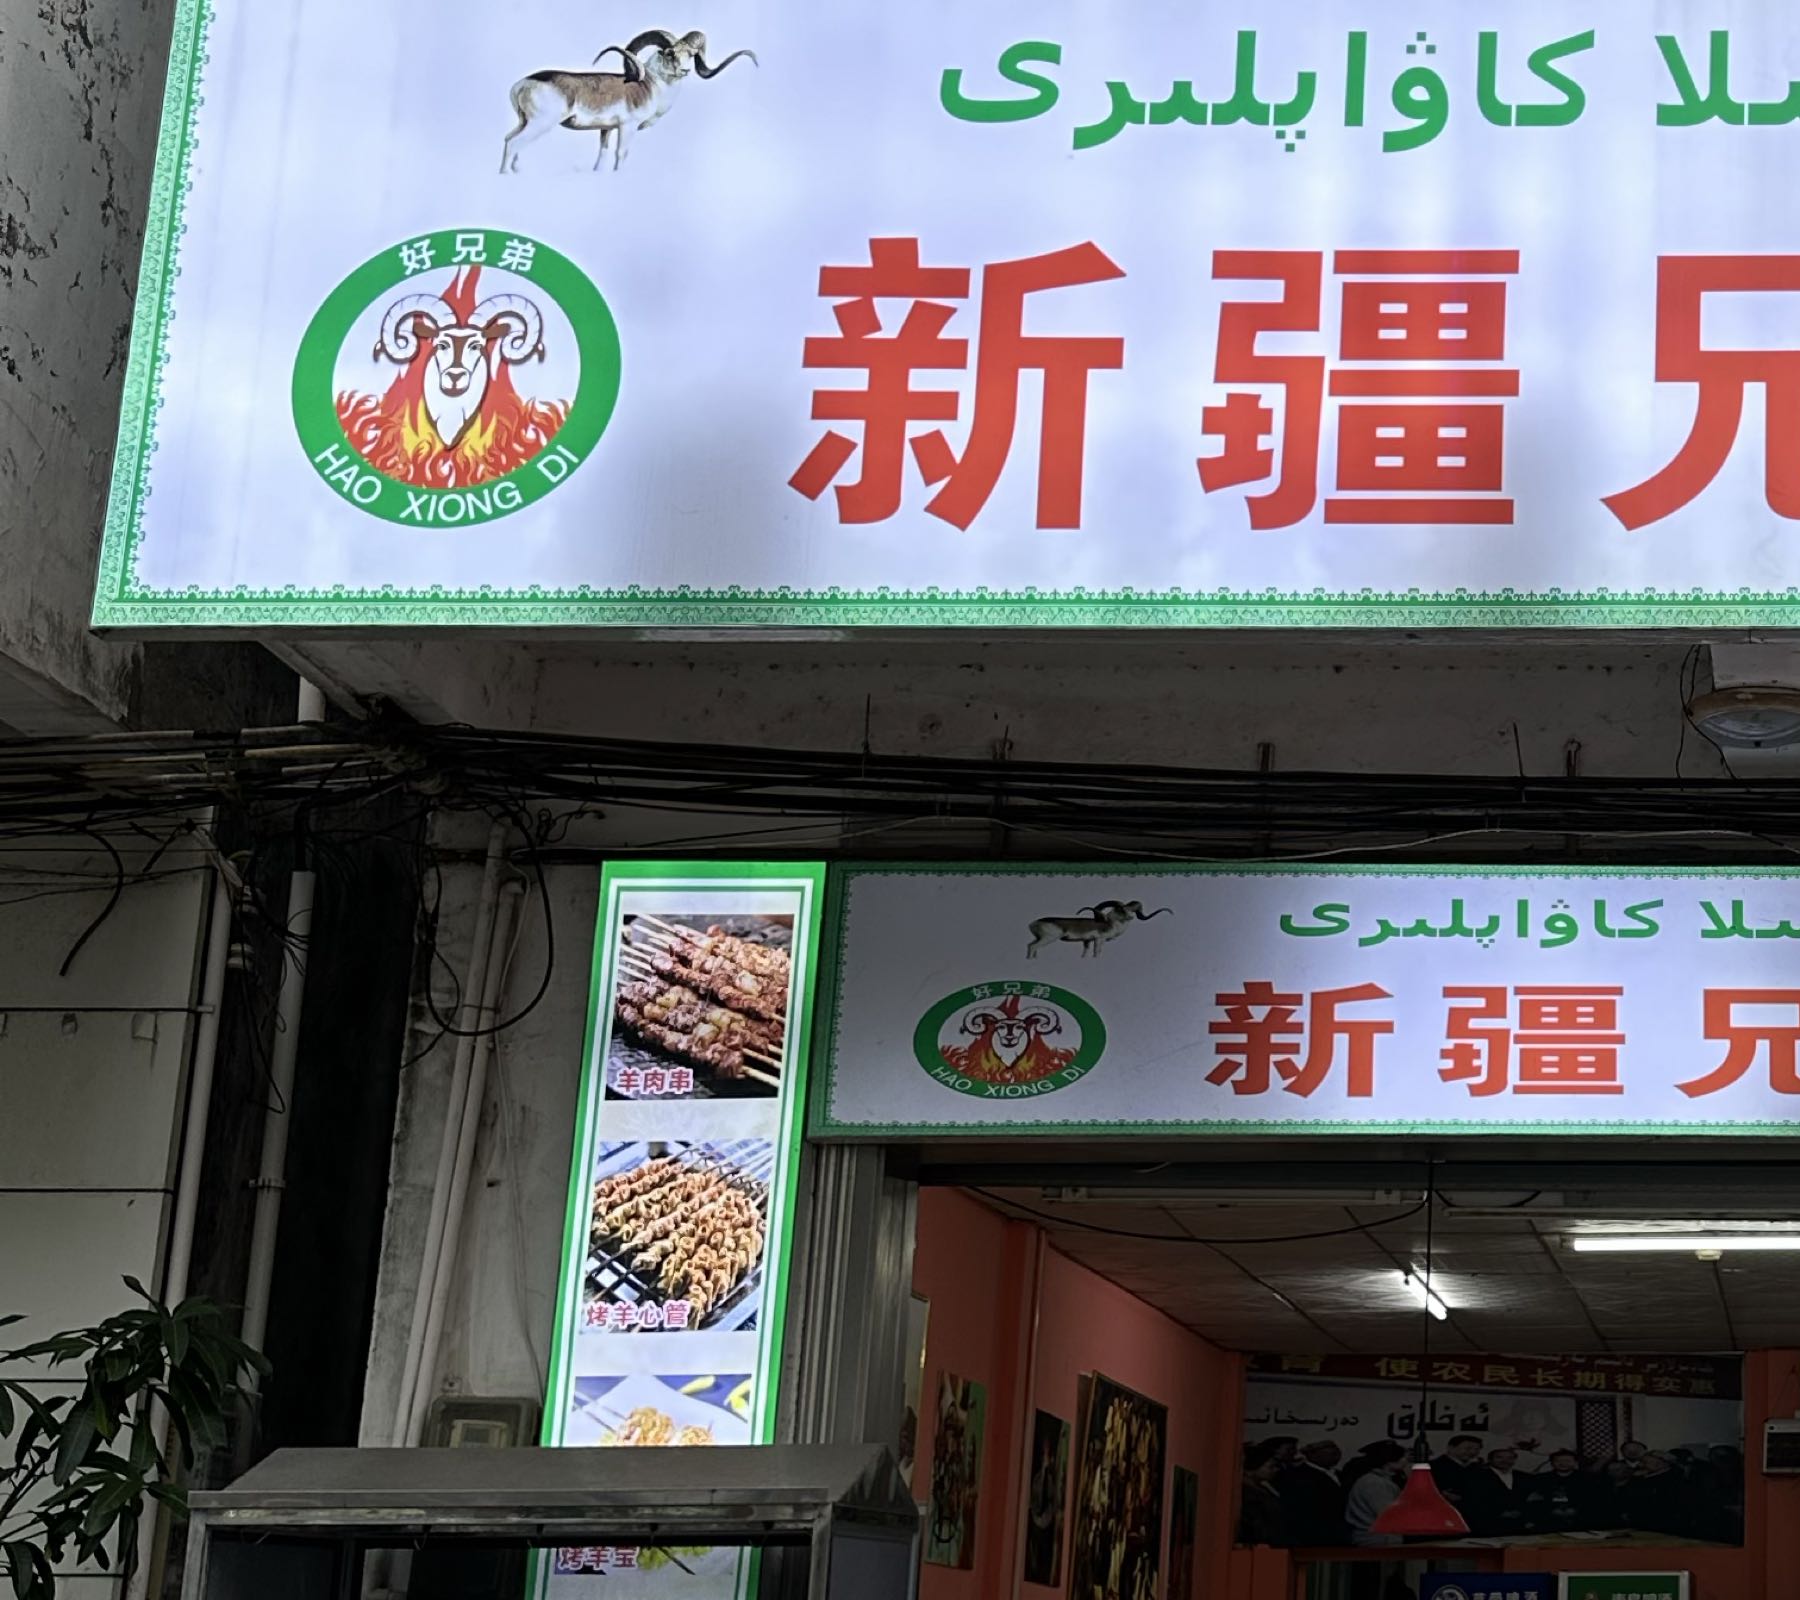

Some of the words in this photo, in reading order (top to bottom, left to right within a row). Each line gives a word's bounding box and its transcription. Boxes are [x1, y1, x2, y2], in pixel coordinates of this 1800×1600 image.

[399, 233, 536, 274] 好兄弟
[314, 443, 383, 503] HAO
[400, 481, 523, 522] XIONG
[536, 445, 580, 484] DI
[973, 982, 1051, 999] 好兄弟
[617, 1068, 693, 1093] 羊肉串
[930, 1065, 973, 1091] HAO
[984, 1079, 1056, 1097] XIONG
[1062, 1065, 1086, 1082] DI
[586, 1302, 690, 1328] 烤羊心管
